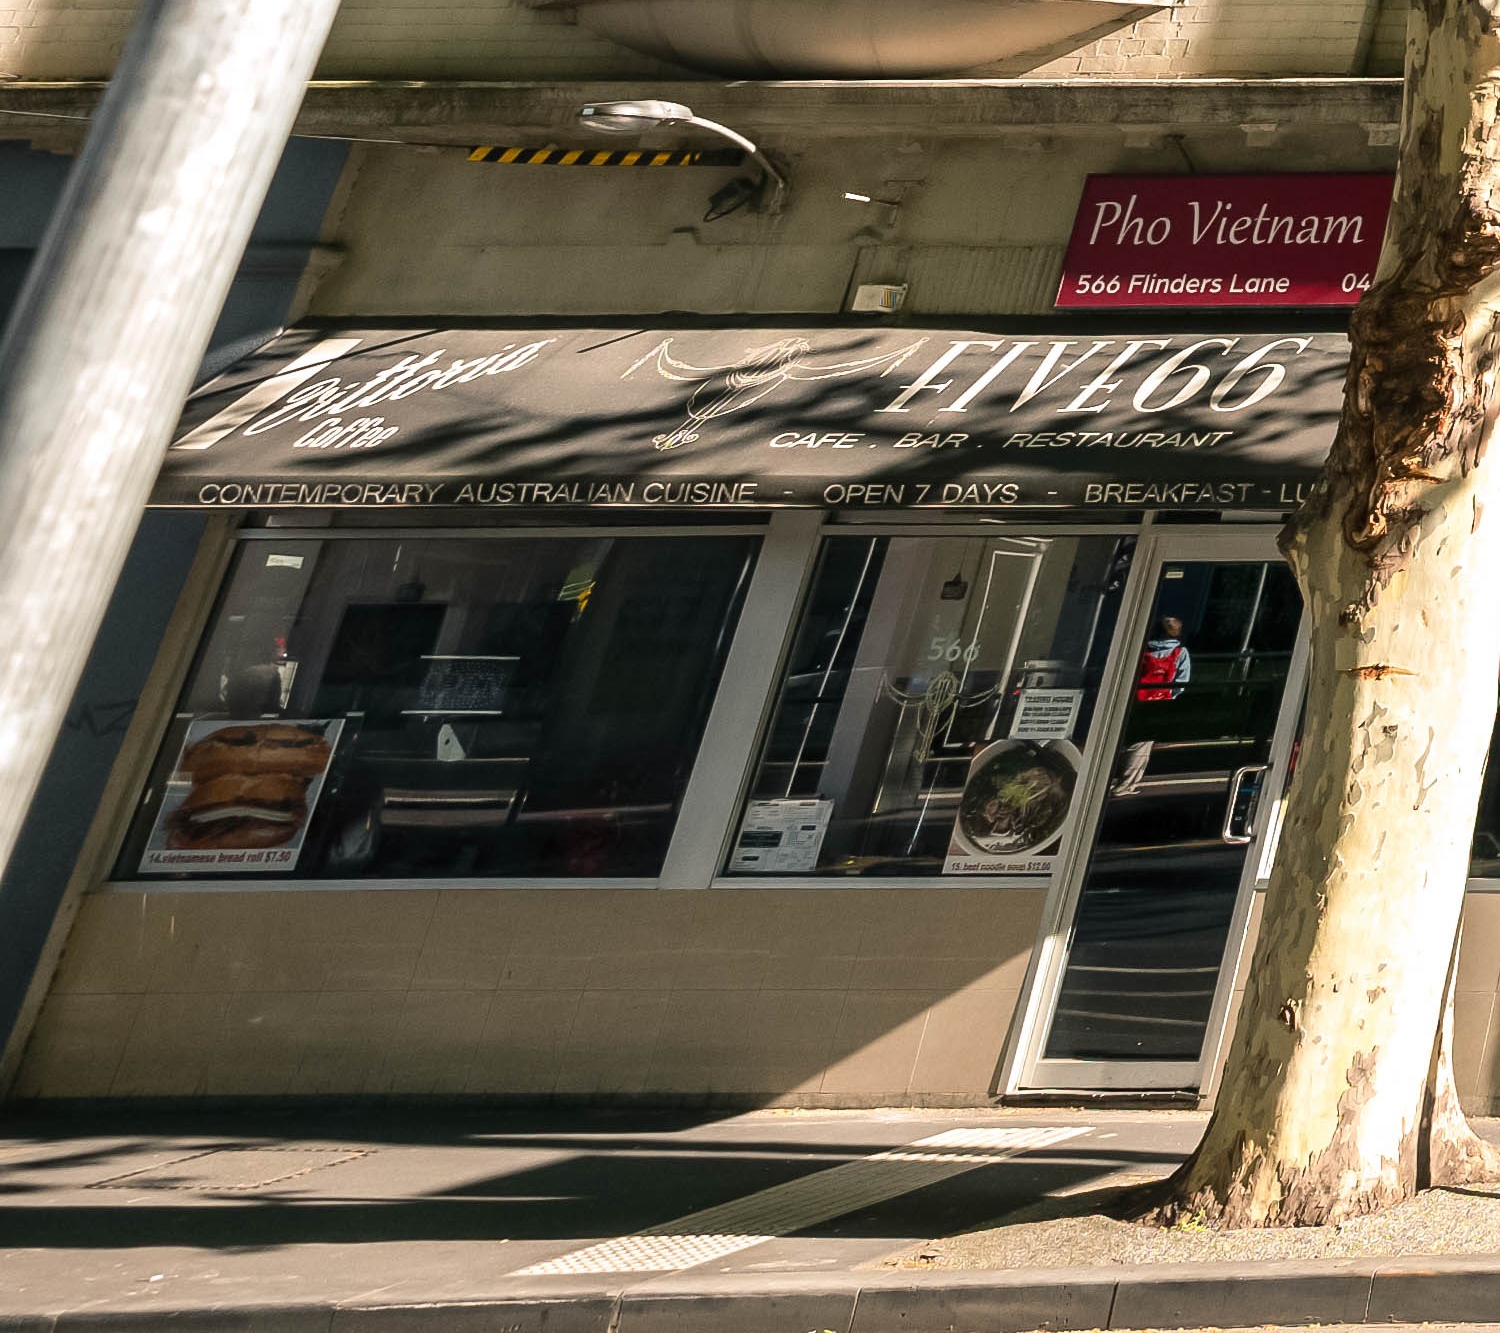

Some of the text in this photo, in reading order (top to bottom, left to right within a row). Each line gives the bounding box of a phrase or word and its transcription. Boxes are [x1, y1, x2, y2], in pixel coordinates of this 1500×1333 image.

[1087, 195, 1364, 245] Pho Vietnam
[1075, 274, 1122, 294] 566
[1128, 273, 1222, 294] Flinders
[1229, 273, 1290, 294] Lane
[874, 336, 1315, 414] FIVE66
[294, 416, 400, 449] Coffee
[770, 431, 1233, 450] CAFE BAR RESTAURANT
[199, 483, 446, 505] CONTEMPORARY
[454, 482, 639, 504] AUSTRALIAN
[642, 482, 758, 504] CUISINE
[823, 483, 904, 505] OPEN
[915, 484, 929, 504] 7
[942, 483, 1020, 504] DAYS
[1084, 483, 1254, 504] BREAKFAST
[927, 636, 981, 662] 566
